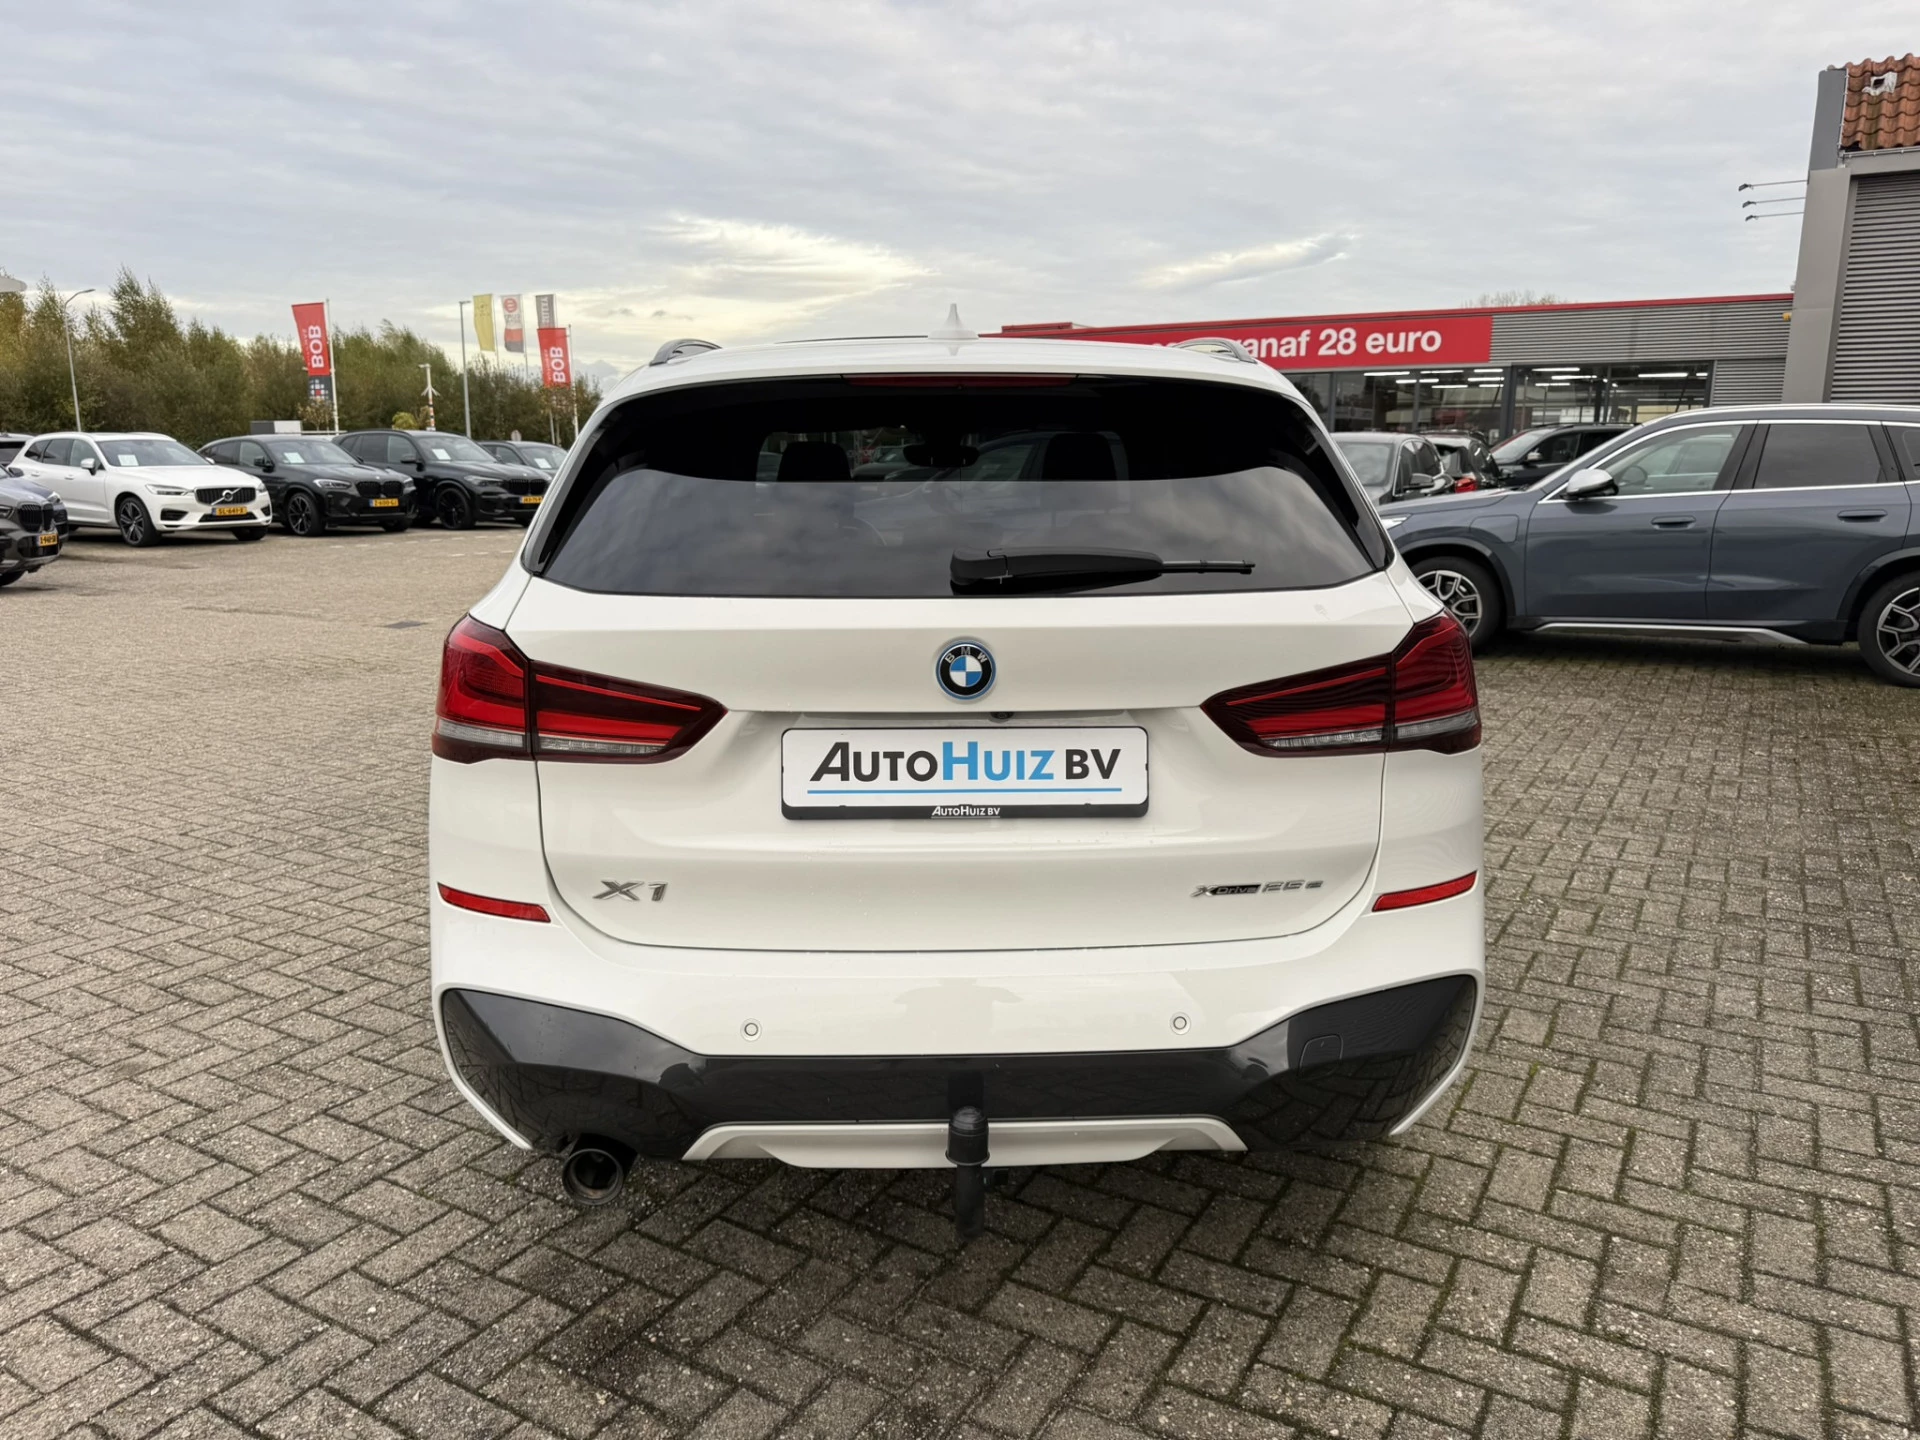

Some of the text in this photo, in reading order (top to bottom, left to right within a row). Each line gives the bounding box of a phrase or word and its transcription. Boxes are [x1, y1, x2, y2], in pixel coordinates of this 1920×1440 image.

[308, 325, 325, 368] BOB
[1236, 327, 1442, 358] anaf 28 euro
[550, 346, 566, 383] BOB
[944, 646, 988, 664] BMW
[1065, 748, 1122, 780] BV
[987, 807, 1001, 816] BV
[592, 880, 669, 902] X1
